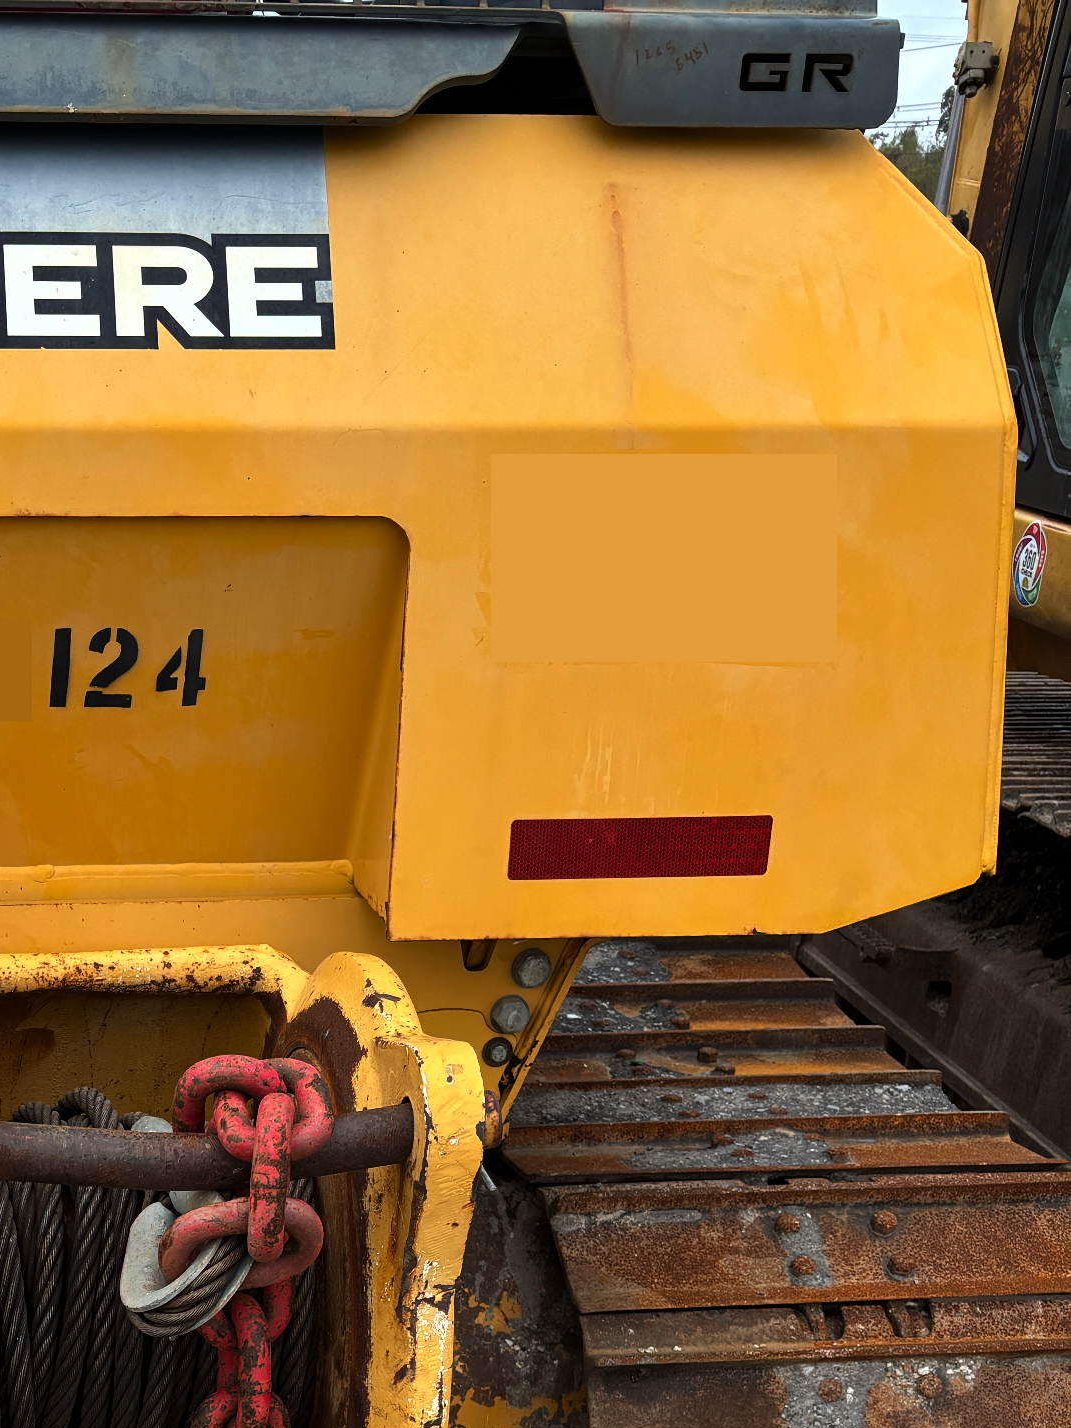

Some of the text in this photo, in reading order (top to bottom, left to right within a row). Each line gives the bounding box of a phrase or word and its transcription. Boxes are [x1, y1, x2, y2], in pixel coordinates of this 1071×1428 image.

[739, 53, 853, 92] GR
[1022, 547, 1036, 571] 360
[49, 627, 207, 709] 124
